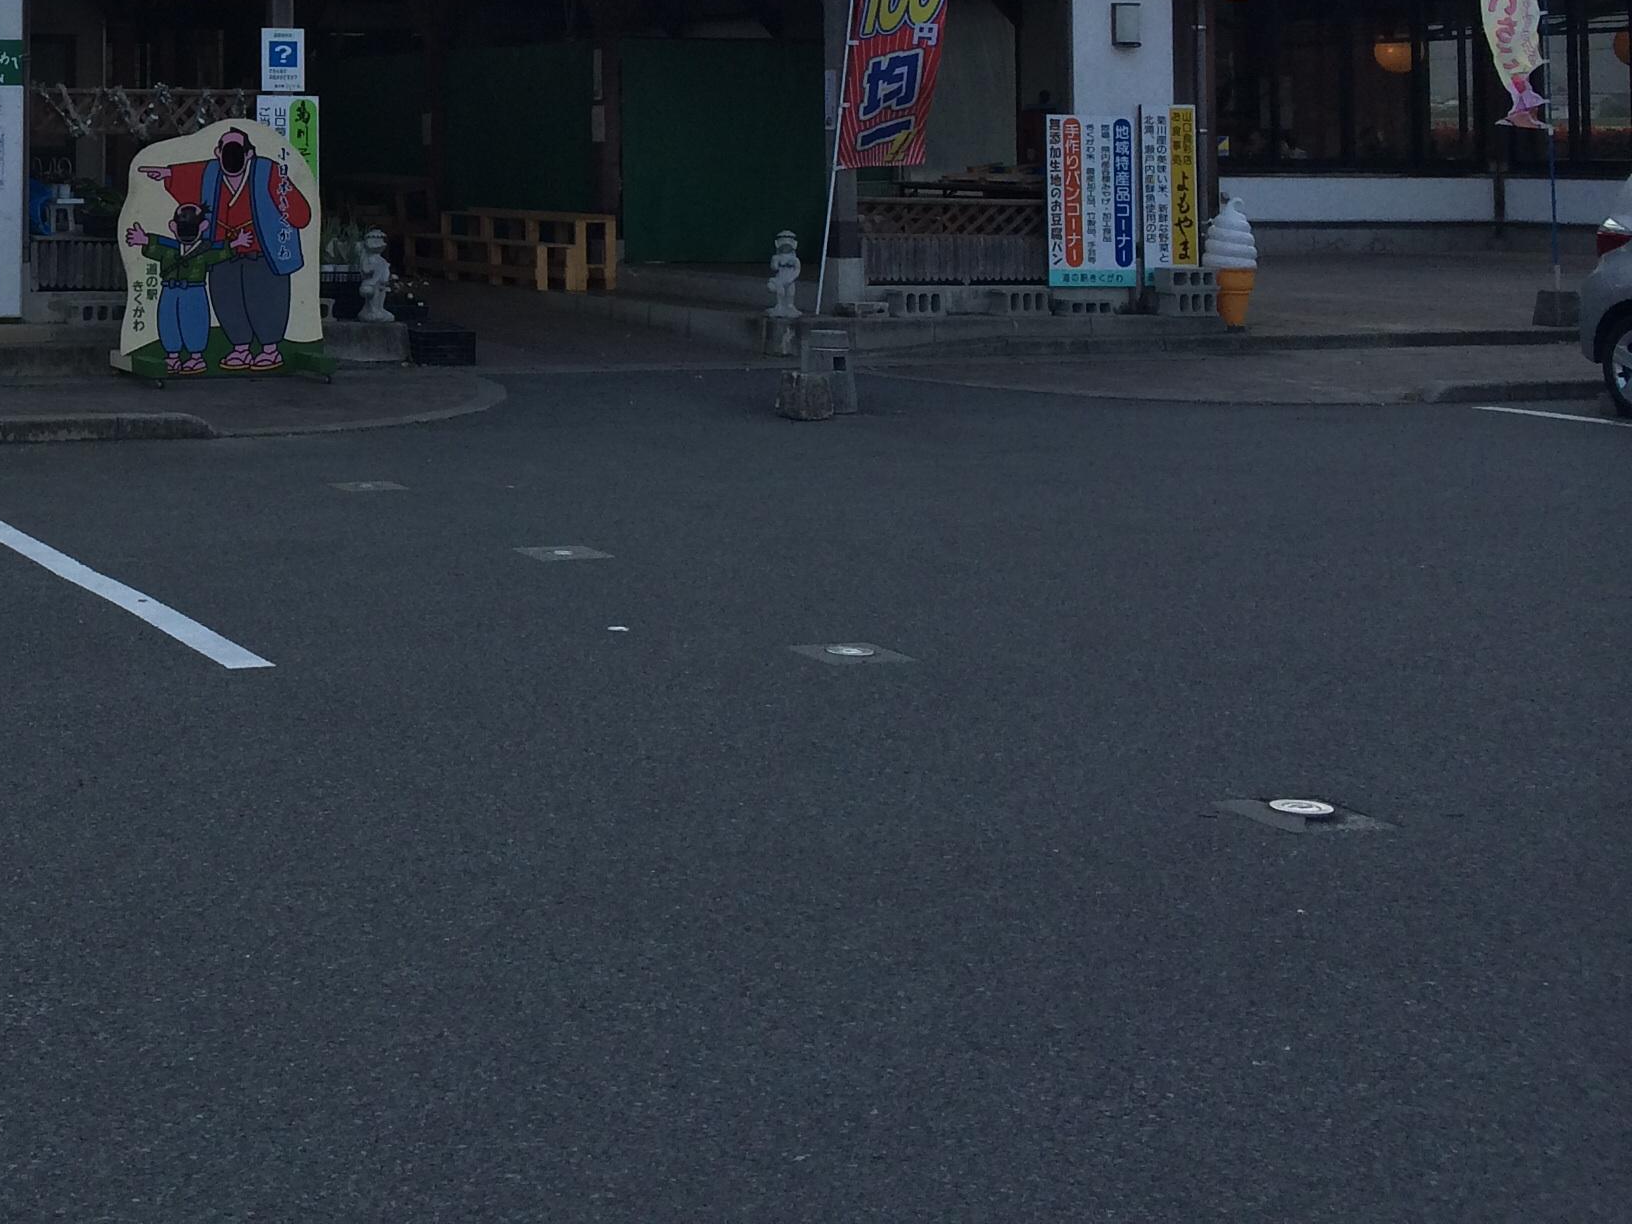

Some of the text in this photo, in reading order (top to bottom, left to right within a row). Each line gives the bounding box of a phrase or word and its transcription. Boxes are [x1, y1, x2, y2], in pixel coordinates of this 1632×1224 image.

[912, 22, 938, 46] 円
[1065, 124, 1082, 262] 手作りパンコーナー
[1115, 125, 1132, 263] 地域特産品コーナー
[1174, 170, 1194, 260] よもやま
[146, 263, 159, 301] 道の駅
[1062, 273, 1124, 284] 道の駅きくがわ
[132, 281, 146, 333] きくがわ
